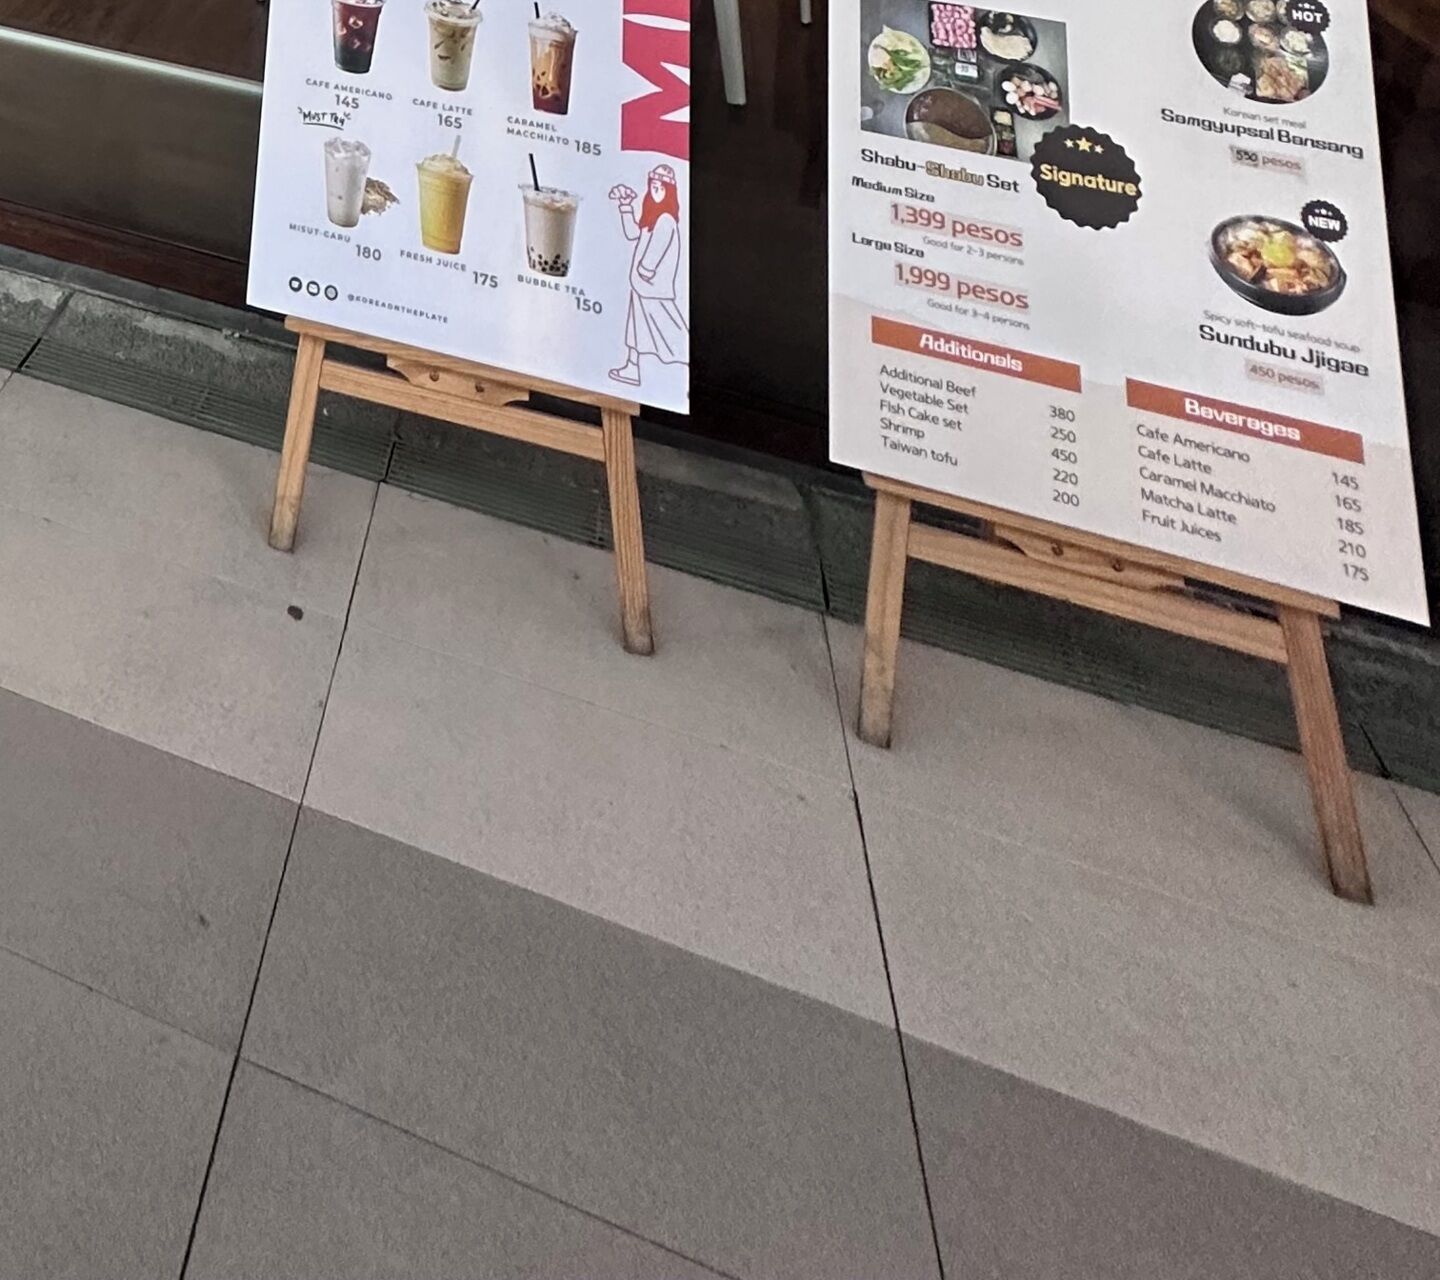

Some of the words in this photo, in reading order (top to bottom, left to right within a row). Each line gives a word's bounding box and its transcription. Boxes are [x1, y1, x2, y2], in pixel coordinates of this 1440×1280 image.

[1291, 8, 1323, 25] HOT
[305, 77, 330, 90] CAFE
[333, 83, 393, 101] AMERICANO
[334, 93, 360, 110] 145
[412, 98, 438, 110] CAFE
[441, 103, 473, 116] LATTE
[437, 113, 463, 130] 165
[1222, 106, 1260, 121] Korean
[1263, 113, 1279, 124] set
[1281, 117, 1307, 129] meal
[506, 127, 570, 146] MACCHIATO
[507, 115, 559, 132] CARAMEL
[1160, 107, 1274, 140] Samgyupsal
[1277, 128, 1364, 160] Bansang
[574, 140, 602, 157] 185
[1261, 154, 1302, 171] pesos
[860, 148, 985, 187] Shabu-Shabu
[986, 173, 1020, 194] Set
[1039, 163, 1138, 196] Signature
[851, 175, 903, 197] Medium
[904, 186, 936, 204] Size
[890, 202, 946, 230] 1,399
[950, 217, 1024, 248] pesos
[1307, 215, 1341, 232] NEW
[354, 243, 383, 262] 180
[399, 249, 433, 265] FRESH
[435, 257, 467, 272] JUICE
[851, 231, 892, 252] Large
[893, 241, 925, 260] Size
[922, 235, 948, 249] Good
[949, 241, 964, 252] for
[985, 249, 1025, 267] persons
[472, 270, 499, 289] 175
[517, 273, 561, 292] BUBBLE
[564, 284, 586, 297] TEA
[894, 262, 951, 291] 1,999
[956, 279, 1030, 310] pesos
[574, 296, 603, 315] 150
[927, 297, 953, 312] Good
[954, 302, 968, 315] for
[992, 313, 1031, 331] persons
[1202, 309, 1232, 326] Spicy
[1287, 328, 1332, 348] seafood
[919, 333, 1023, 372] Additionals
[1199, 323, 1296, 360] Sundubu
[1301, 347, 1370, 377] Jjigae
[1249, 364, 1275, 379] 450
[1277, 371, 1321, 390] pesos
[879, 364, 944, 390] Additional
[945, 380, 978, 397] Beef
[1048, 404, 1076, 423] 380
[879, 381, 944, 408] Vegetable
[947, 398, 969, 415] Set
[1050, 425, 1077, 444] 250
[1184, 397, 1301, 441] Beverages
[879, 417, 926, 440] Shrimp
[1052, 467, 1079, 486] 220
[907, 407, 940, 426] Cake
[942, 415, 963, 431] set
[1051, 446, 1078, 465] 450
[881, 435, 928, 458] Taiwan
[931, 449, 959, 467] tofu
[1052, 489, 1080, 508] 200
[1136, 423, 1169, 443] Cafe
[1173, 432, 1251, 464] Americano
[1331, 471, 1359, 491] 145
[1137, 445, 1171, 464] Cafe
[1173, 453, 1213, 475] Latte
[1334, 494, 1363, 513] 165
[1139, 466, 1198, 492] Caramel
[1200, 481, 1277, 513] Macchiato
[1336, 516, 1365, 536] 185
[1140, 487, 1194, 514] Matcha
[1197, 502, 1238, 525] Latte
[1338, 539, 1367, 560] 210
[1141, 508, 1177, 530] Fruit
[1180, 518, 1222, 543] Juices
[1342, 562, 1370, 582] 175
